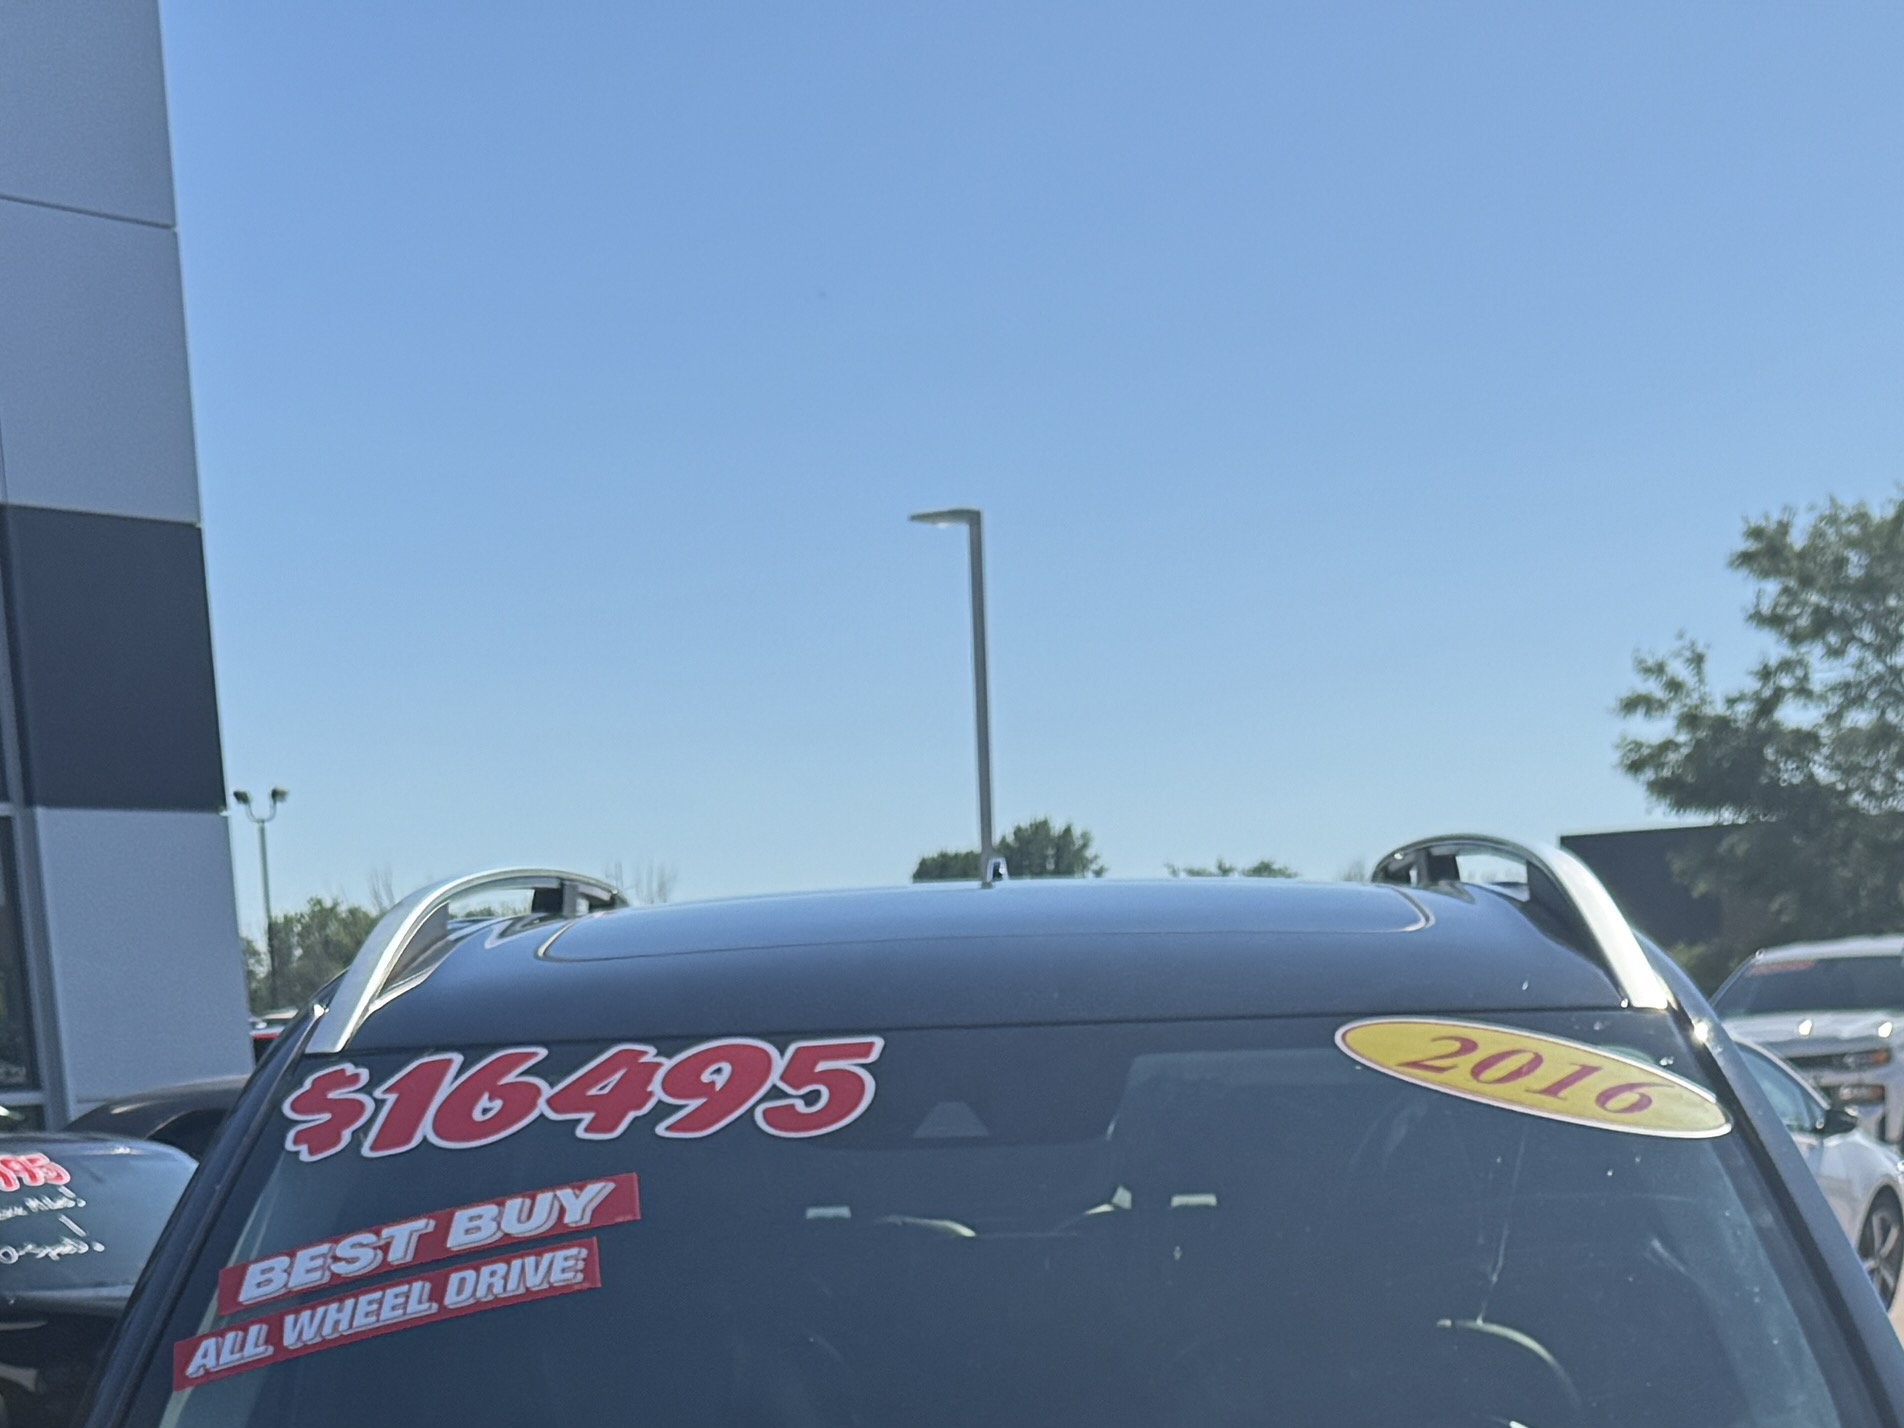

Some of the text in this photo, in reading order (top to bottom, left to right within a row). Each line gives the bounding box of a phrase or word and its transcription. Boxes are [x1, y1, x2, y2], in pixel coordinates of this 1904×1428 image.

[282, 1036, 886, 1162] $16495
[1397, 1035, 1676, 1114] 2016
[237, 1181, 618, 1305] BEST BUY
[185, 1245, 588, 1379] ALL WHEEL DRIVE
